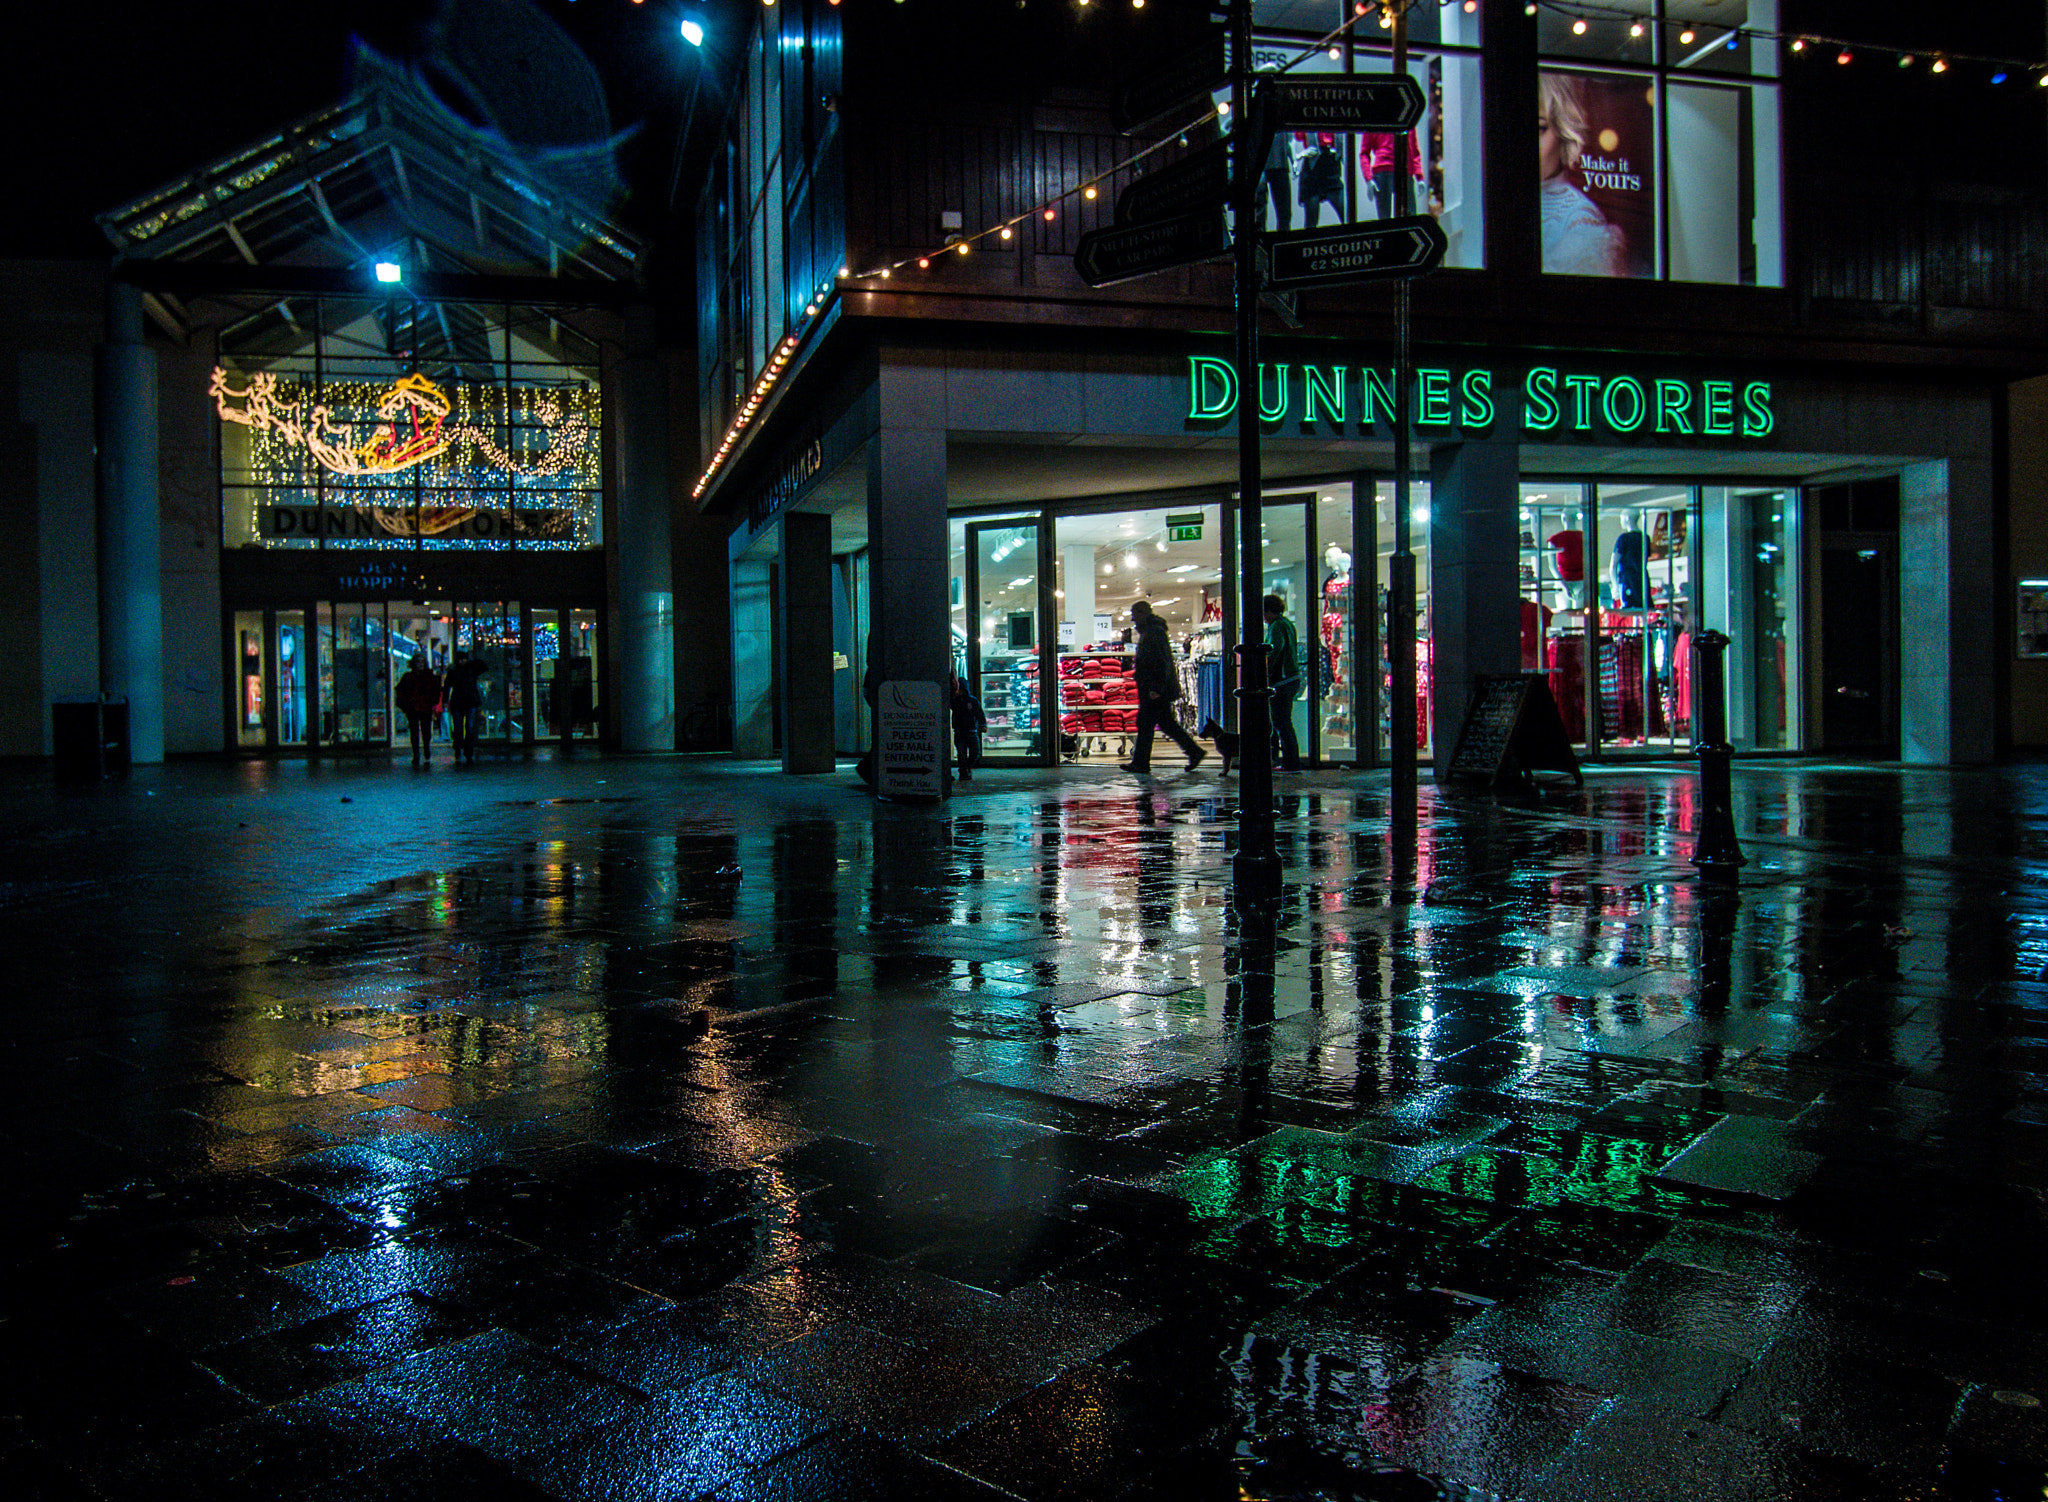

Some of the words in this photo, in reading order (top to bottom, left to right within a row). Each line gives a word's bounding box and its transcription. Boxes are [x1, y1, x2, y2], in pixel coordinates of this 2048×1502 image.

[1288, 87, 1375, 102] MULTIPLEX
[1301, 106, 1361, 119] CINEMA
[1580, 155, 1614, 172] Make
[1617, 157, 1629, 173] it
[1582, 170, 1641, 192] yours
[1116, 249, 1142, 267] CAR
[1143, 243, 1176, 262] PARK
[1301, 238, 1383, 258] DISCOUNT
[1310, 260, 1327, 271] €2
[1330, 253, 1374, 269] SHOP
[1186, 354, 1496, 430] DUNNES
[1524, 366, 1774, 438] STORES
[274, 508, 415, 536] DUNN
[892, 731, 928, 741] PLEASE
[886, 742, 905, 752] USE
[906, 742, 934, 752] MALL
[884, 753, 936, 763] ENTRANCE
[888, 778, 914, 788] Thank
[916, 778, 931, 788] You
